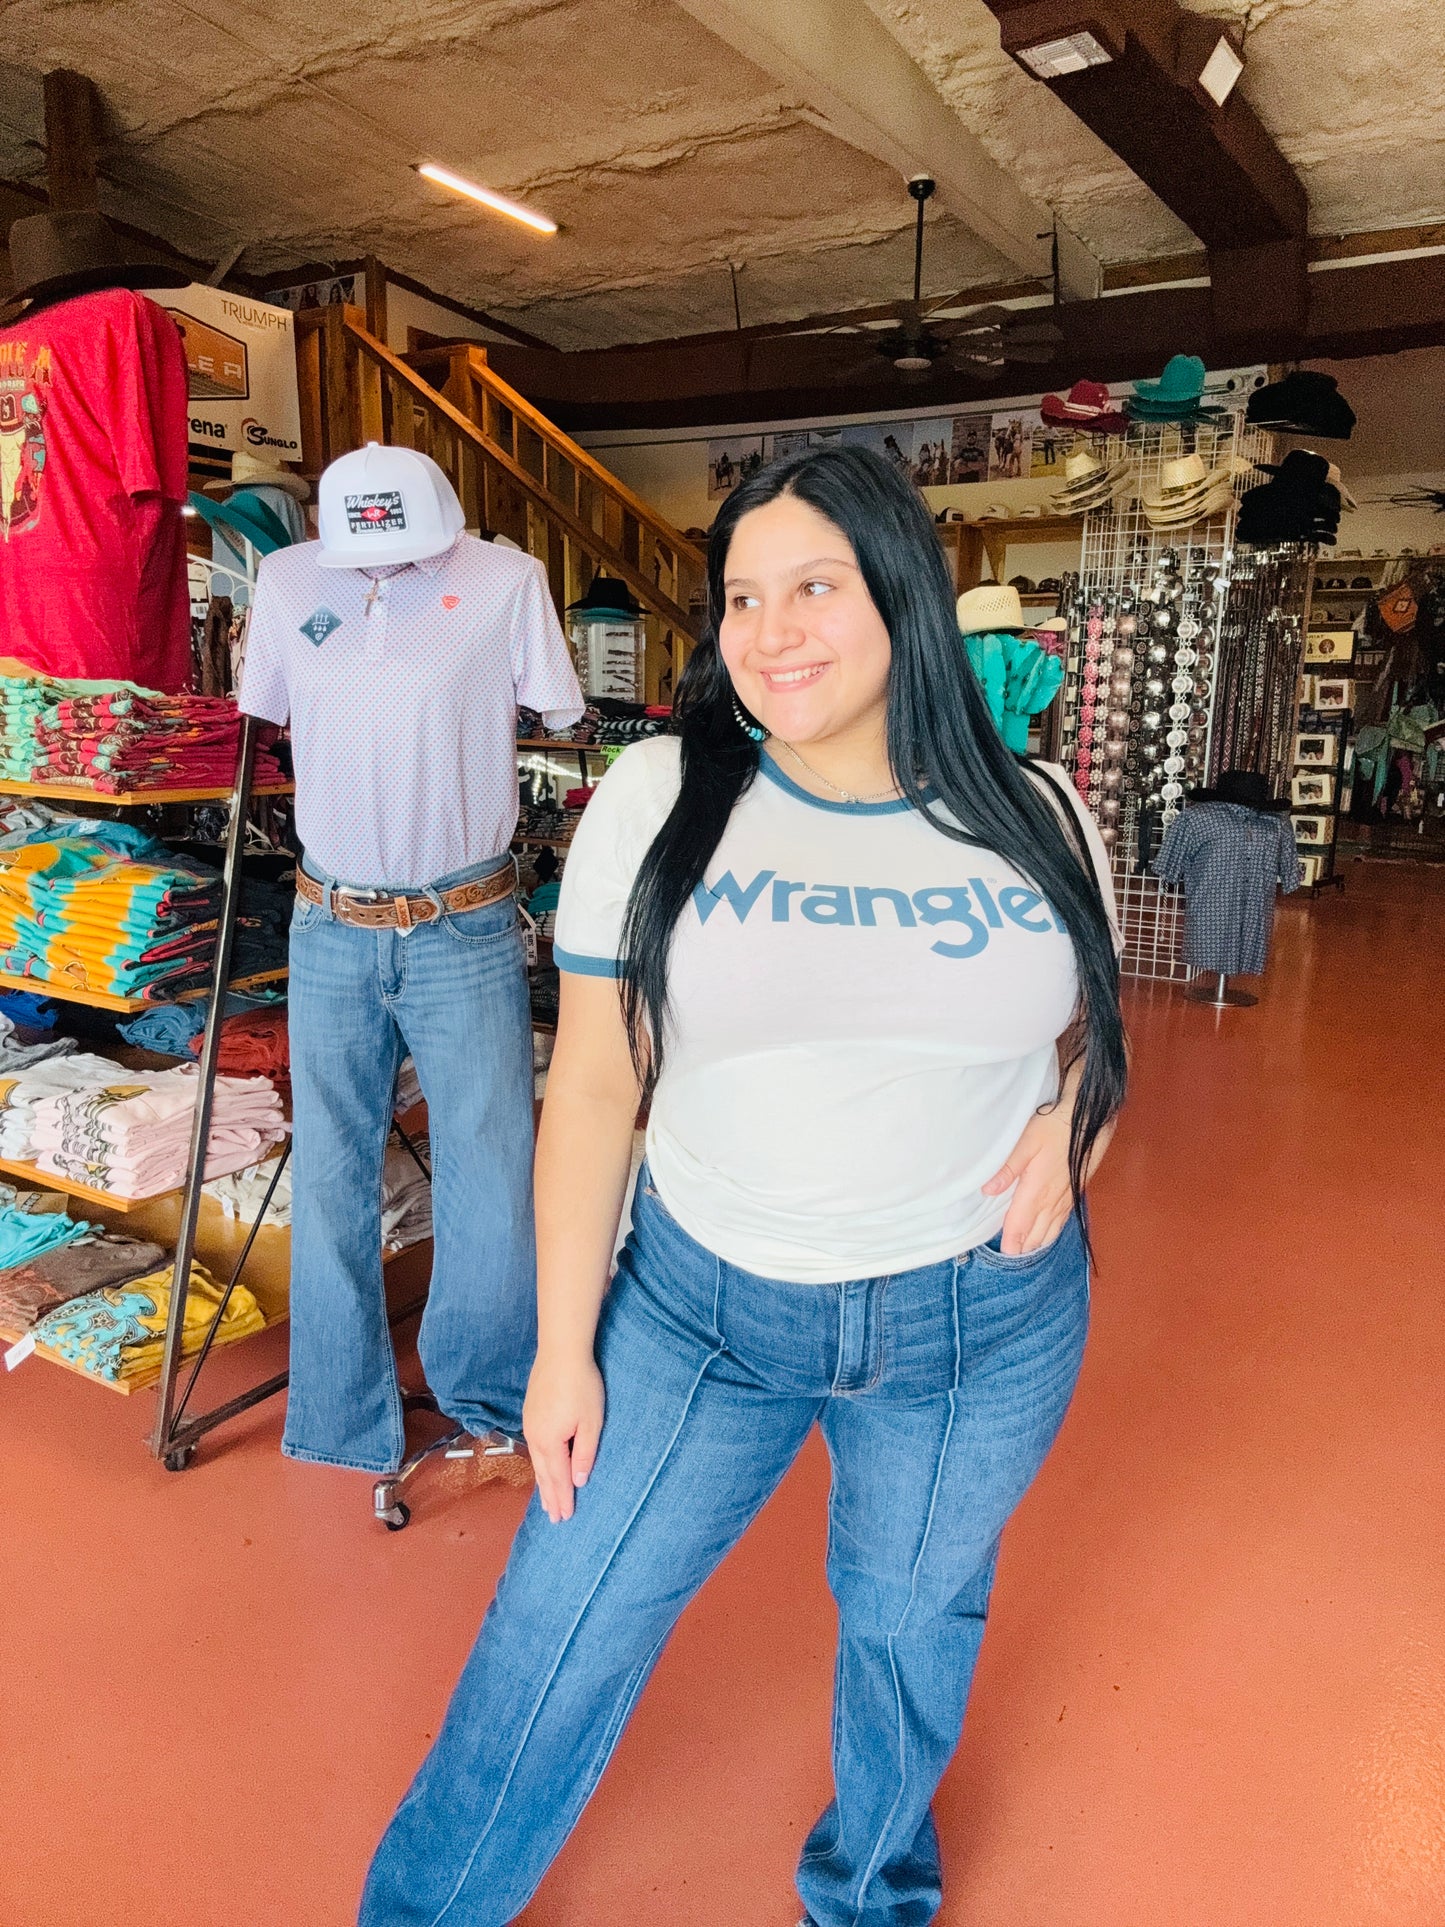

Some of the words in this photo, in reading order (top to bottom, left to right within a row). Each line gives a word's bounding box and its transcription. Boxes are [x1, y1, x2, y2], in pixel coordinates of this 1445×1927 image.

[220, 299, 287, 332] TRIUMPH
[188, 417, 226, 439] ena
[601, 745, 620, 753] Rock
